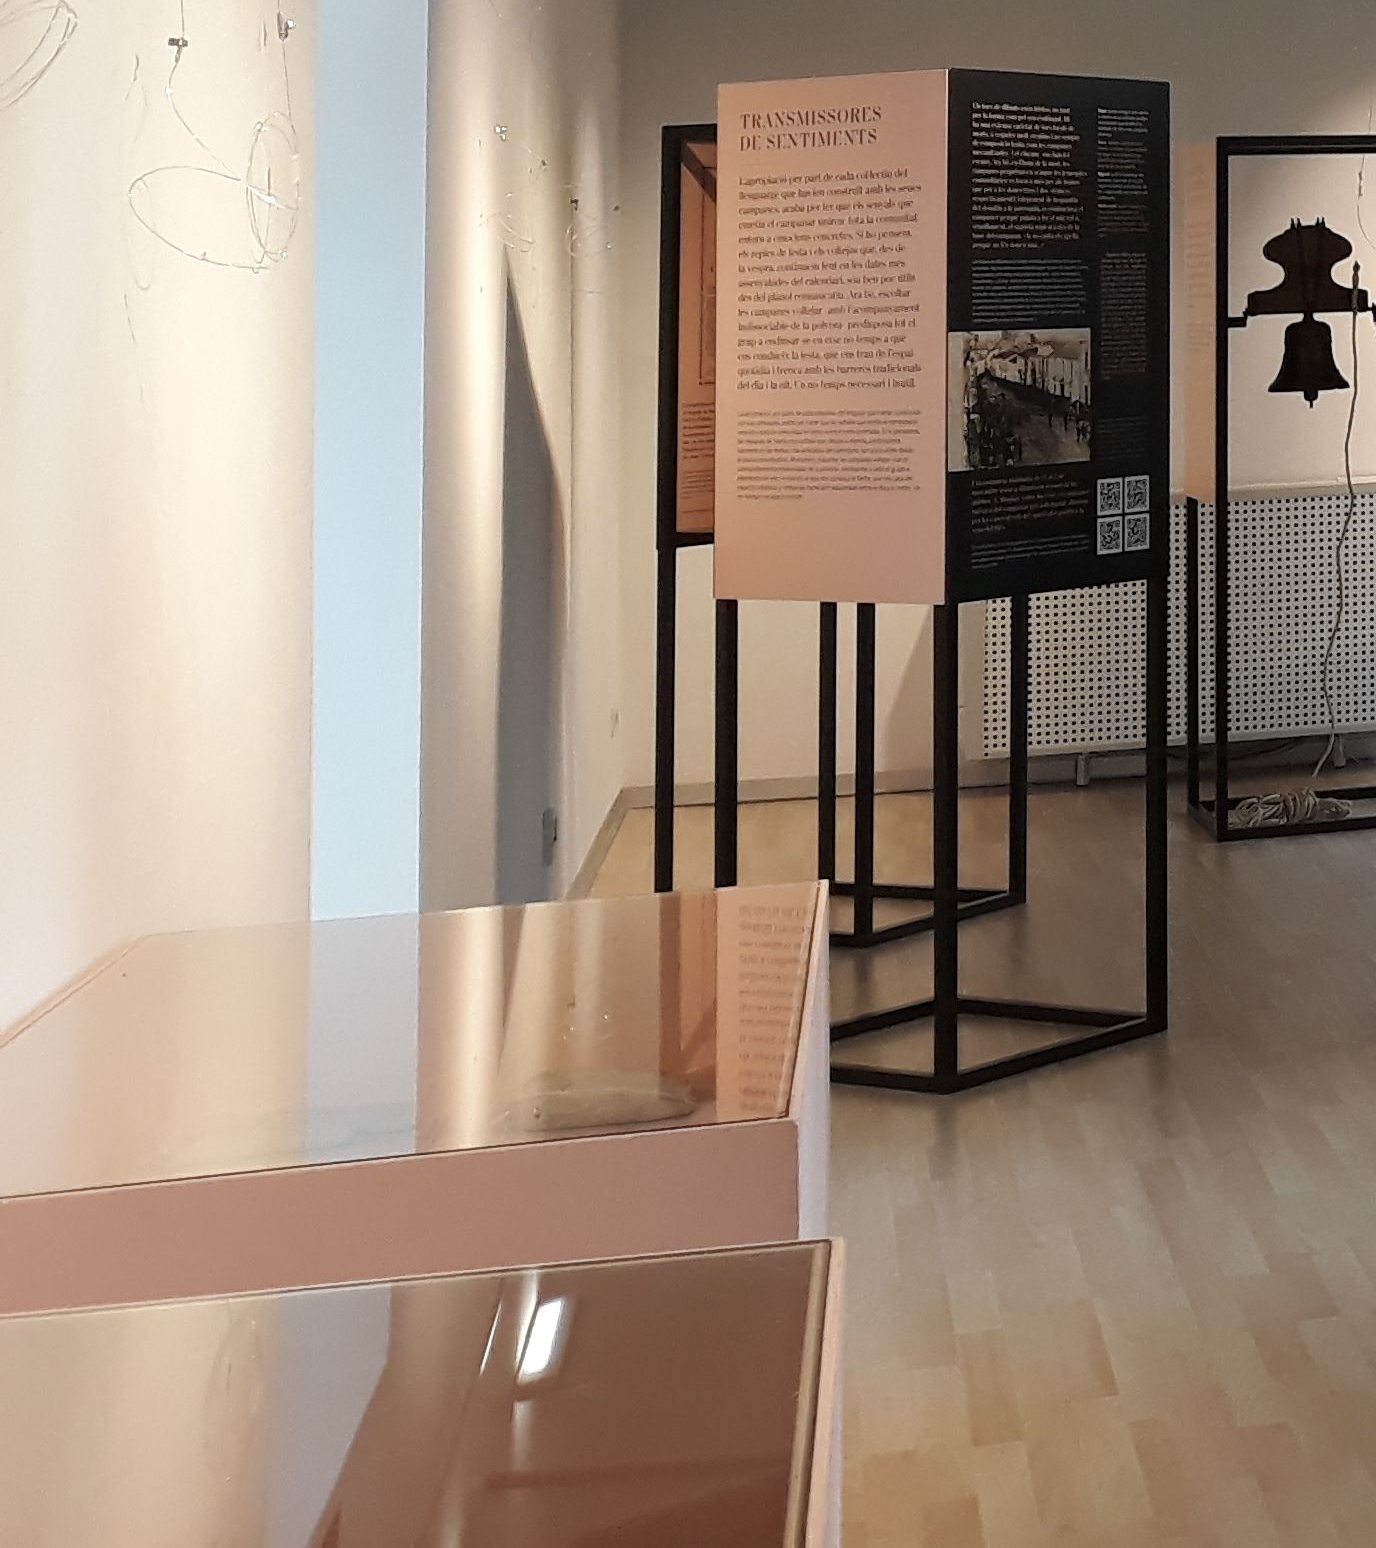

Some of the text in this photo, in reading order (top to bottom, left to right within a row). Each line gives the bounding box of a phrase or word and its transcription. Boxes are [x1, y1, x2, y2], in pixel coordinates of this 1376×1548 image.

[740, 105, 883, 129] TRANSMISSORES
[740, 128, 878, 152] DE SENTIMENTS
